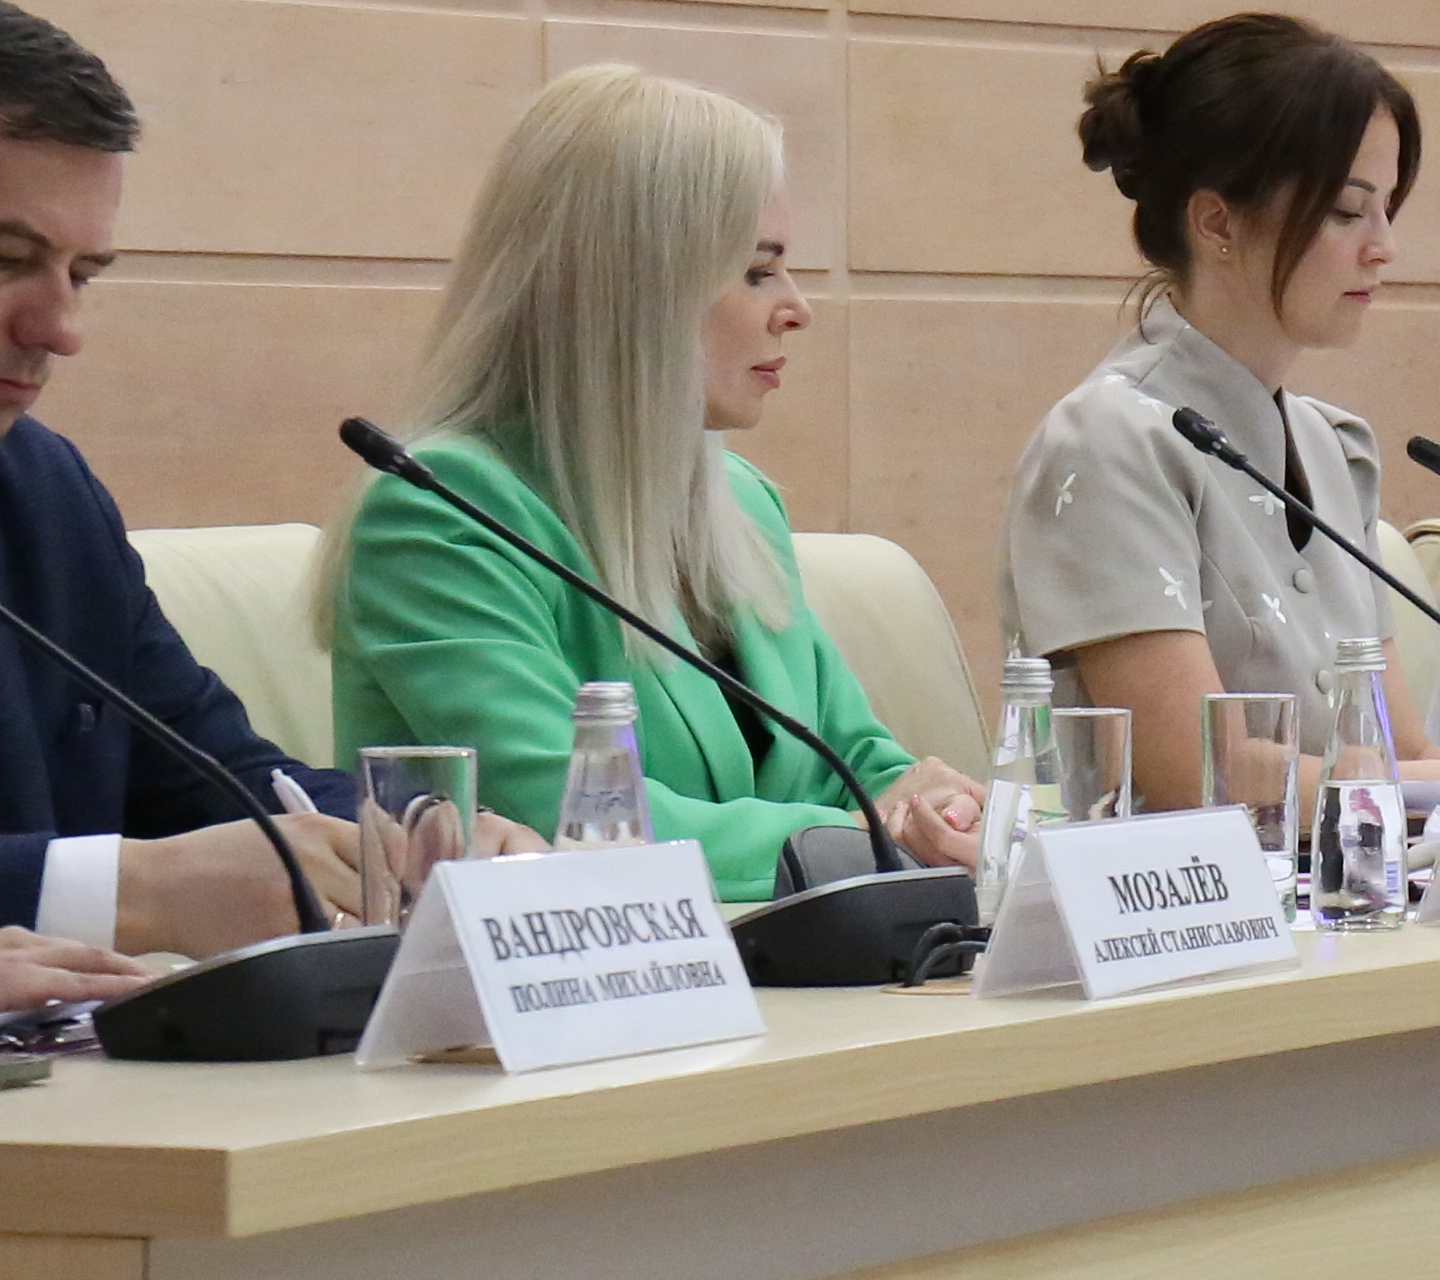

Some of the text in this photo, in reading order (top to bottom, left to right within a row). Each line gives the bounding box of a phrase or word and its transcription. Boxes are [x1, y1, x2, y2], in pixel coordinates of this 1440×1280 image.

[1107, 855, 1230, 915] МОЗАЛЁВ
[482, 898, 707, 961] ВАНДРОВСКАЯ
[1093, 916, 1280, 964] АЛЕКСЕЙ СТАНИСЛАВОВИЧ
[508, 960, 726, 1013] ПОЛИНА МИХАЙЛОВНА
